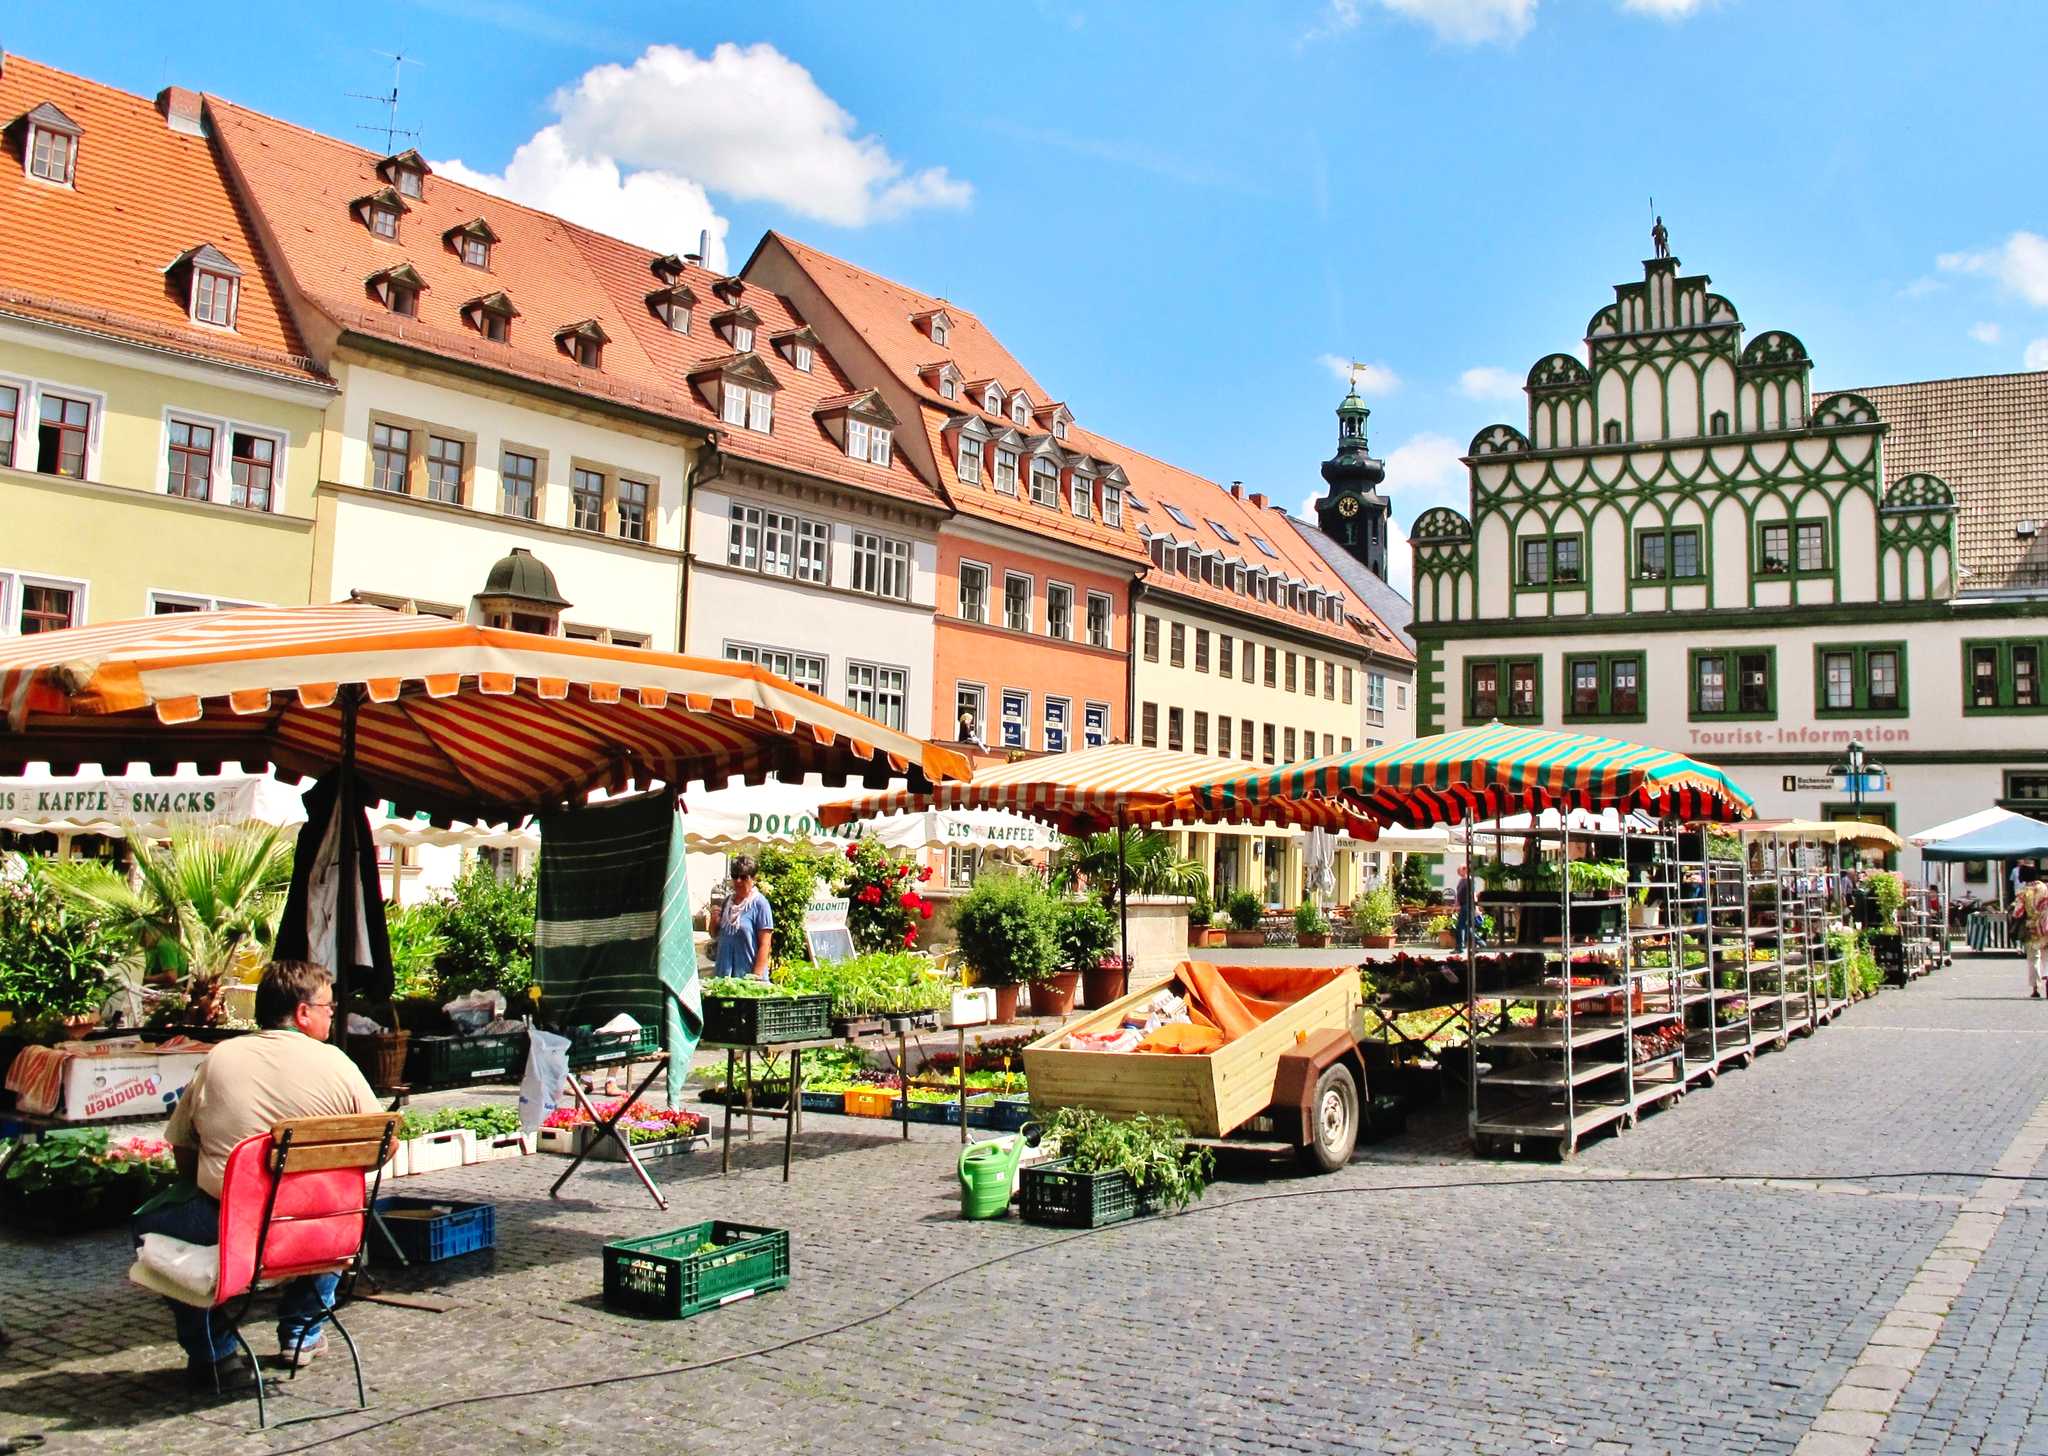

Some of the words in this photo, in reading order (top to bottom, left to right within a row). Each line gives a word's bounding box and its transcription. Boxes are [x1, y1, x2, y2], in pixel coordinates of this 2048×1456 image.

[1689, 728, 1762, 744] Tourist
[1778, 726, 1909, 743] Information
[38, 791, 109, 811] KAFFEE
[132, 791, 216, 812] SNACKS
[948, 823, 970, 838] EIS
[987, 826, 1035, 841] KAFFEE
[808, 901, 848, 912] DOLOMITI
[84, 1078, 157, 1116] Bananen
